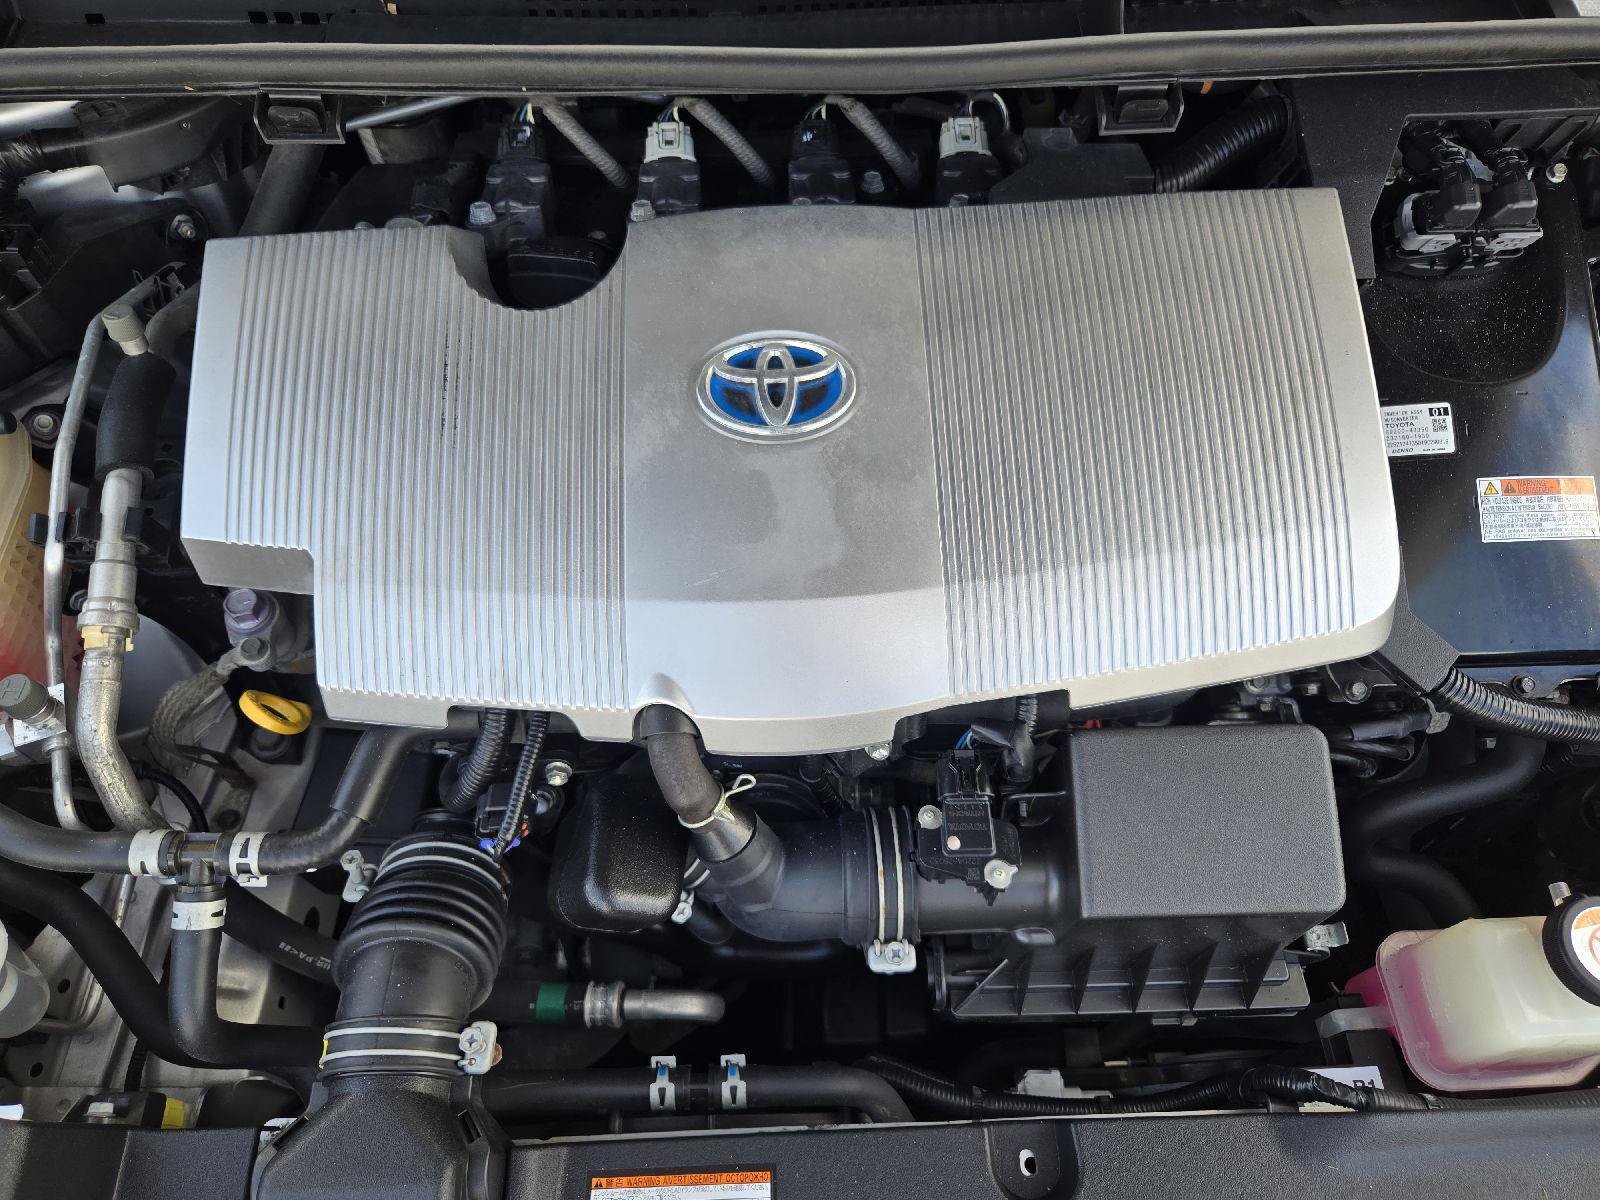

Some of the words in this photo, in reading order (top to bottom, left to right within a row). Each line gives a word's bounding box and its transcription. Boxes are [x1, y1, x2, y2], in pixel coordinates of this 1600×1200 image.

[1432, 407, 1444, 416] 01
[605, 1178, 624, 1188] 警告
[626, 1176, 661, 1187] WARNING
[663, 1174, 722, 1185] AVERTISSEMENT
[726, 1172, 769, 1183] ОСТОРОЖНО
